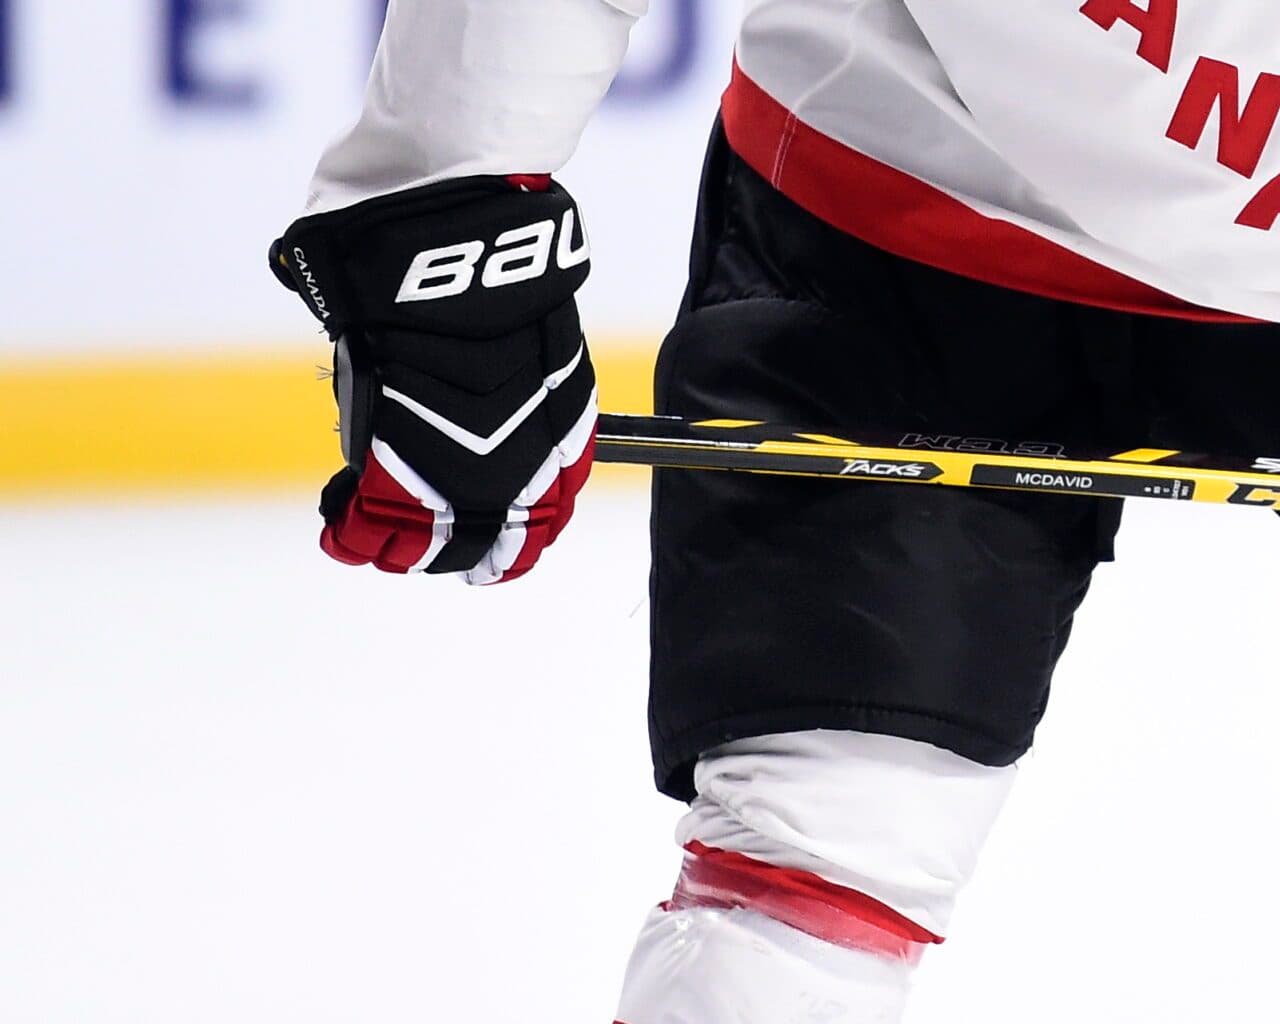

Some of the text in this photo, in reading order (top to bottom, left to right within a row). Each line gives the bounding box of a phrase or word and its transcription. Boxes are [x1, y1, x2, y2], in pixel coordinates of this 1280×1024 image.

[293, 246, 331, 319] CANADA
[840, 459, 926, 477] TACKS
[1015, 472, 1094, 490] MCDAVID
